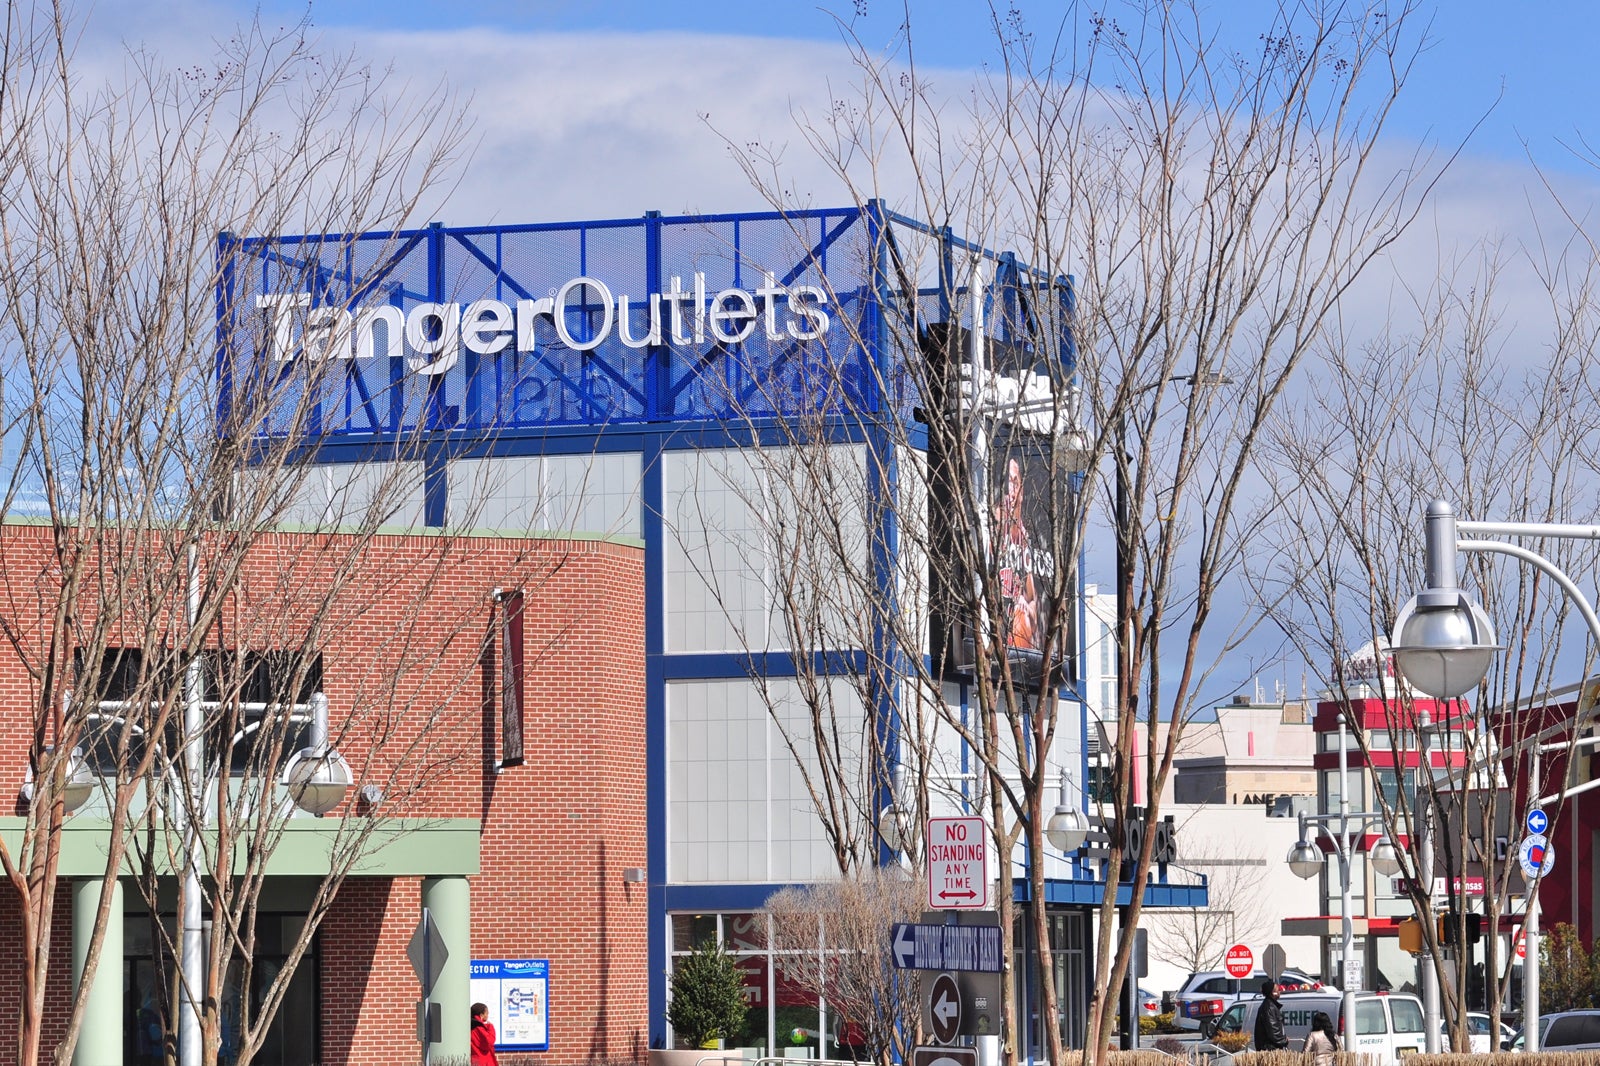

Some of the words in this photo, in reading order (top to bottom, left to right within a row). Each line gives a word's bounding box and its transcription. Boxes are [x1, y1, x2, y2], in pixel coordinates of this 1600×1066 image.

[946, 824, 967, 842] NO
[931, 844, 983, 863] STANDING
[945, 863, 969, 875] ANY
[944, 877, 971, 889] TIME
[1452, 880, 1483, 890] rknsas
[914, 925, 942, 968] HISTORIC
[944, 926, 978, 970] GARDNER'S
[979, 927, 999, 971] BASIN
[1229, 950, 1238, 958] DO
[1239, 950, 1250, 958] NOT
[470, 965, 500, 974] ECTORY
[504, 961, 545, 969] TangerOutlets
[1231, 964, 1248, 973] ENTER
[1281, 1010, 1318, 1026] ERIFF
